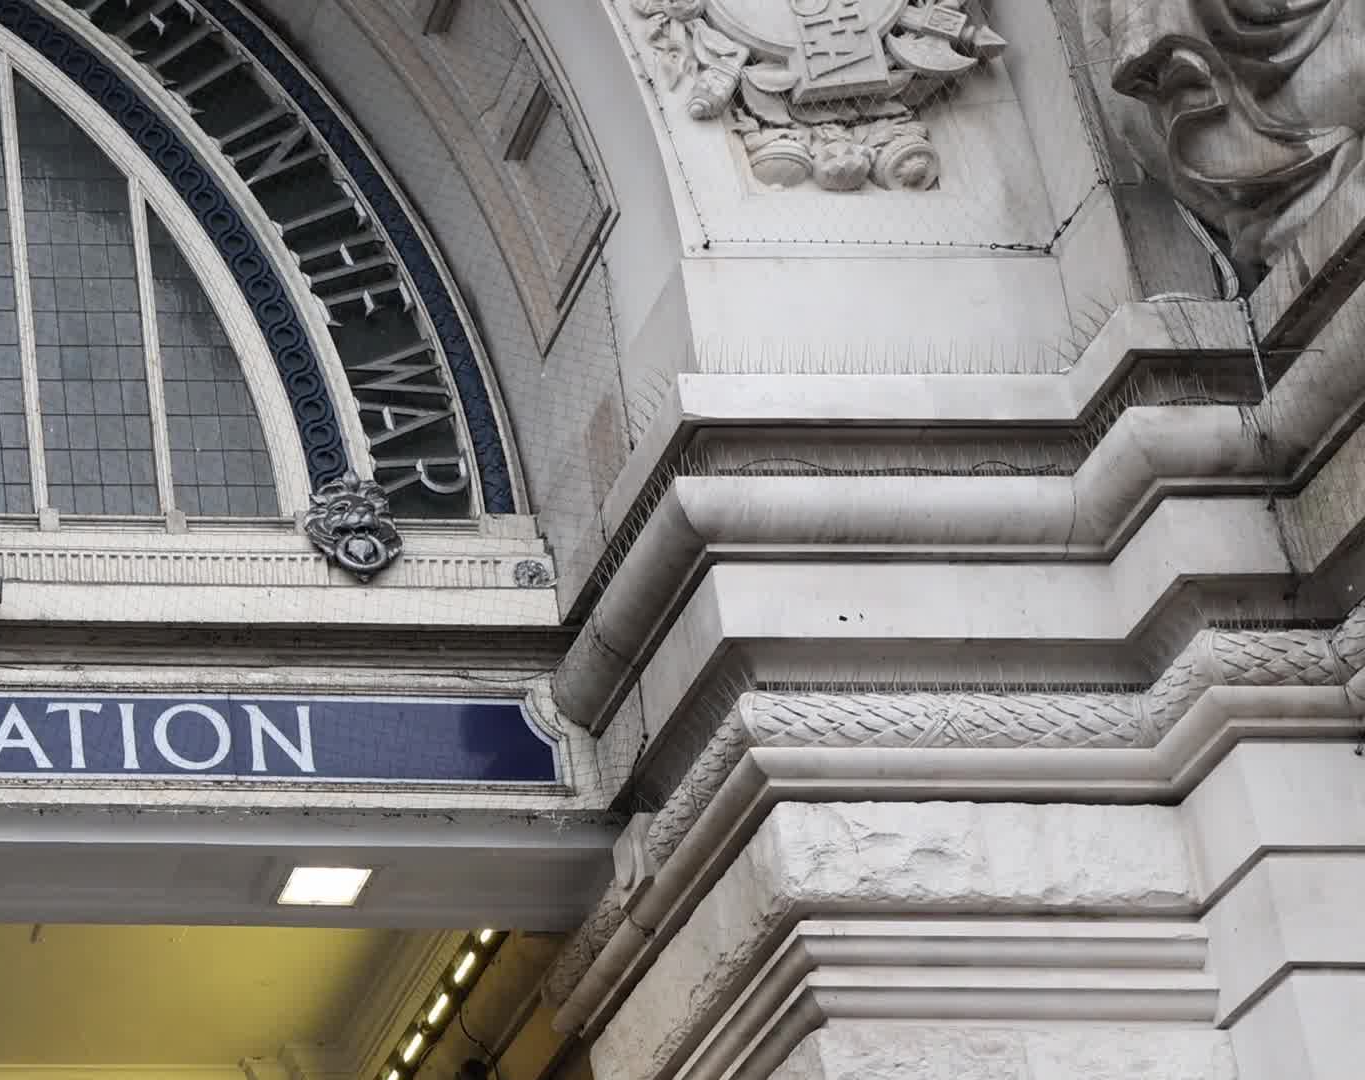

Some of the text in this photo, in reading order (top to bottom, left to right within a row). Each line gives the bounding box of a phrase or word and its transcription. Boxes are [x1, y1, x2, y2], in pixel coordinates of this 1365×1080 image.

[210, 102, 331, 186] IN
[270, 176, 416, 328] THE
[345, 335, 470, 497] WAR
